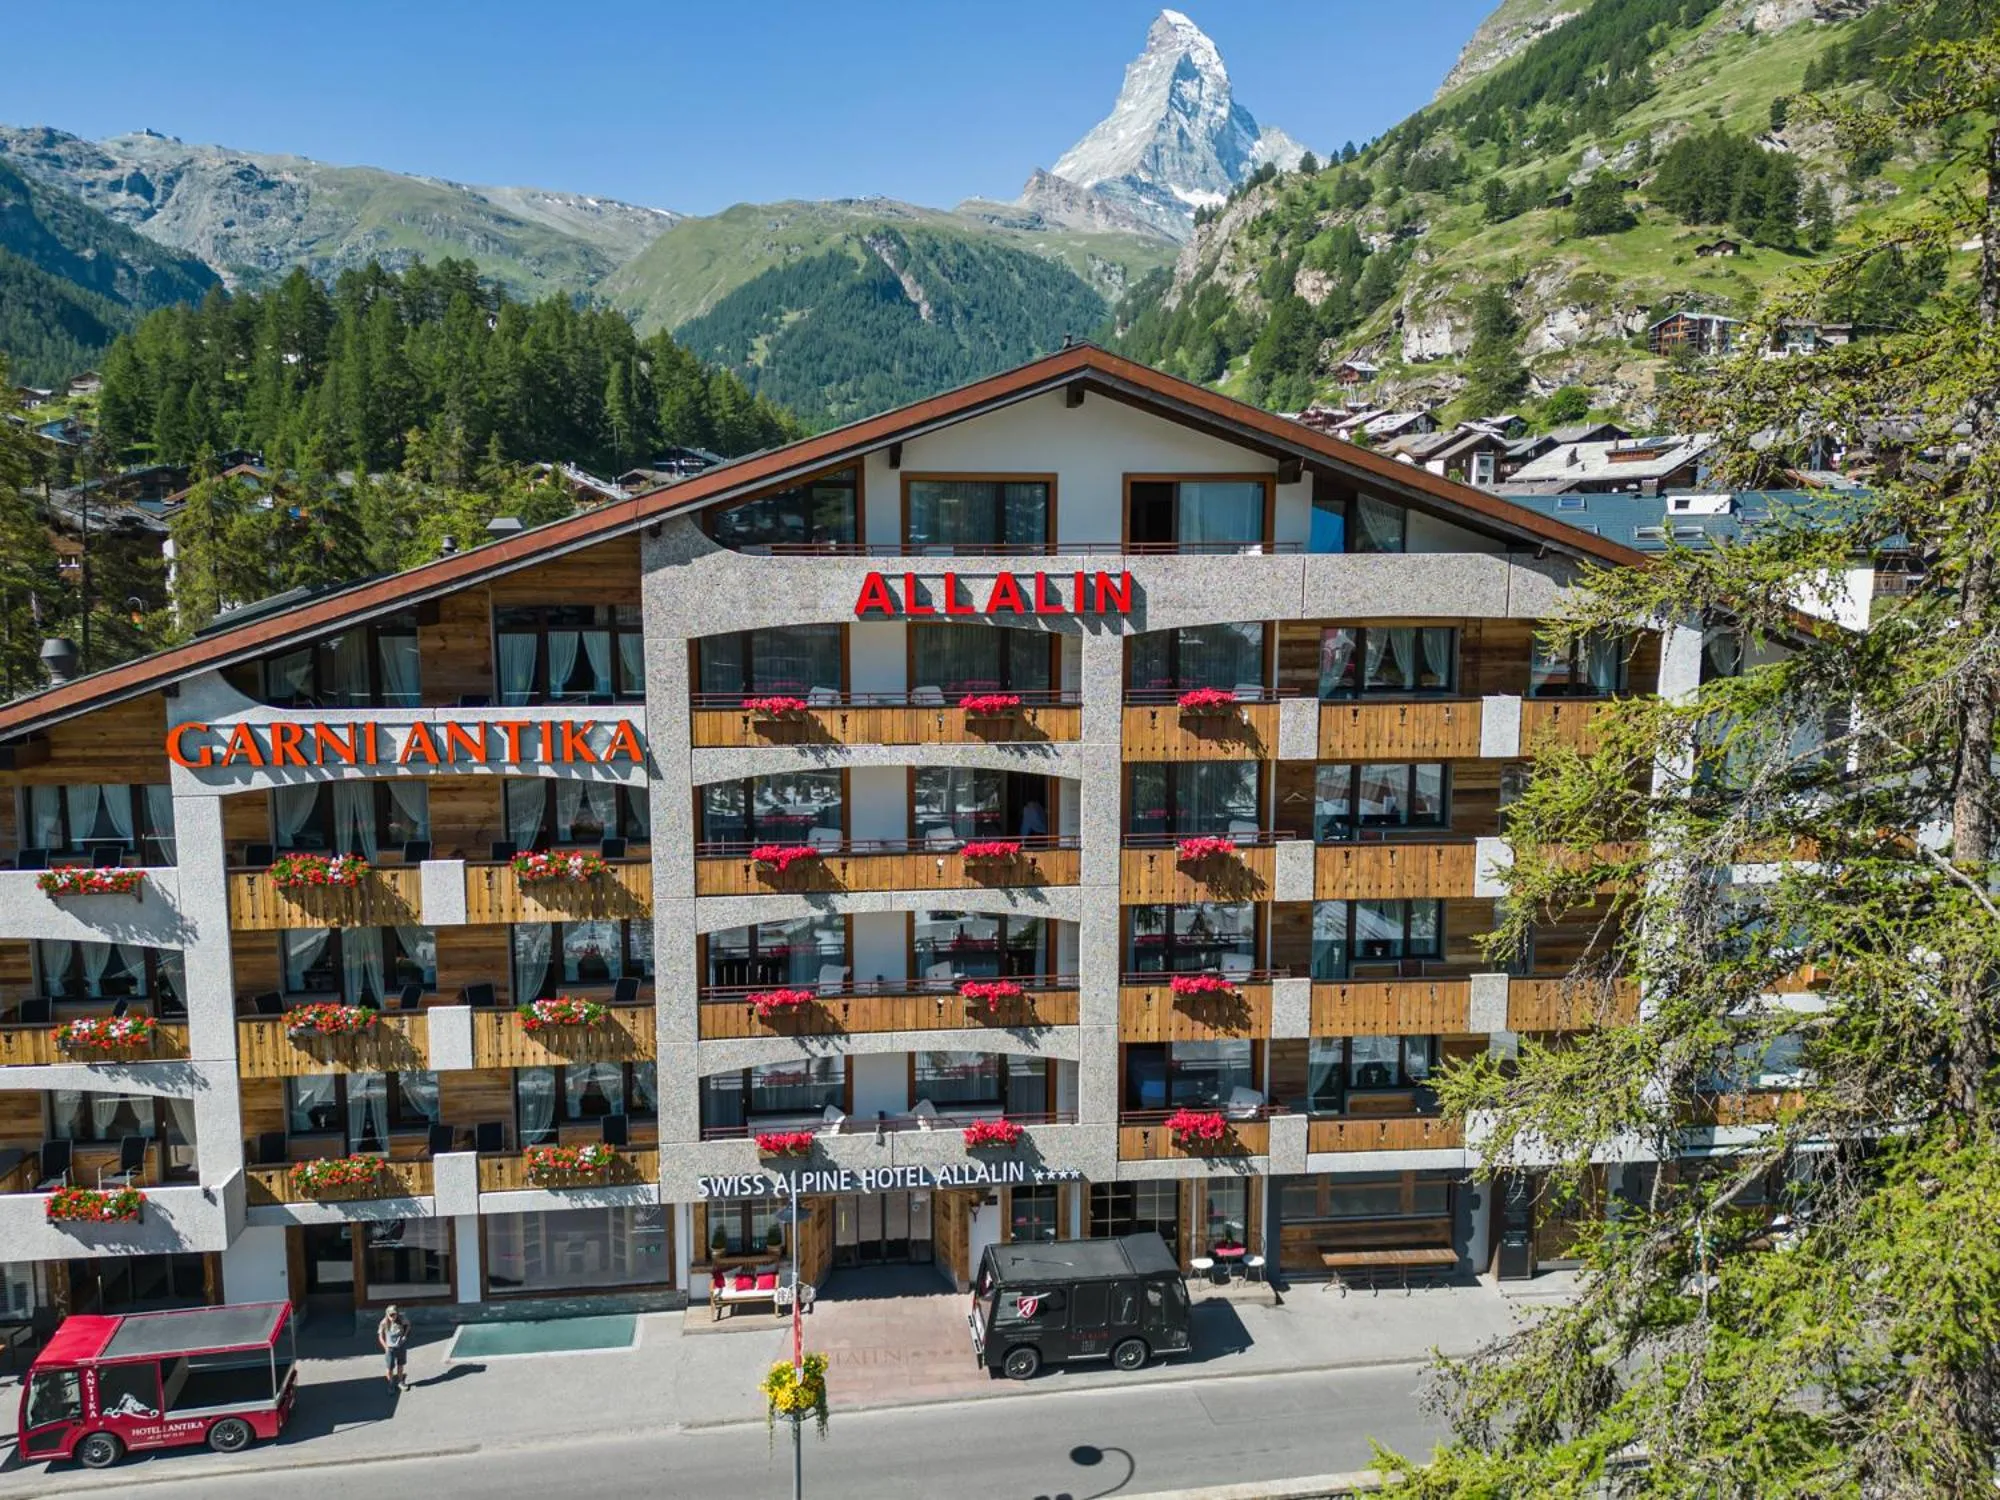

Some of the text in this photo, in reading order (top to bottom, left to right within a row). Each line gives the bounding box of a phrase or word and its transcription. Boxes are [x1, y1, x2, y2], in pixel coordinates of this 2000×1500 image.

[854, 571, 1132, 615] ALLALIN
[166, 719, 645, 769] GARNI ANTIKA
[697, 1174, 765, 1198] SWISS
[863, 1166, 930, 1189] HOTEL
[937, 1161, 1024, 1186] ALLALIN
[86, 1369, 98, 1418] ANTIKA
[131, 1426, 162, 1437] HOTEL
[167, 1421, 204, 1433] ANTIKA
